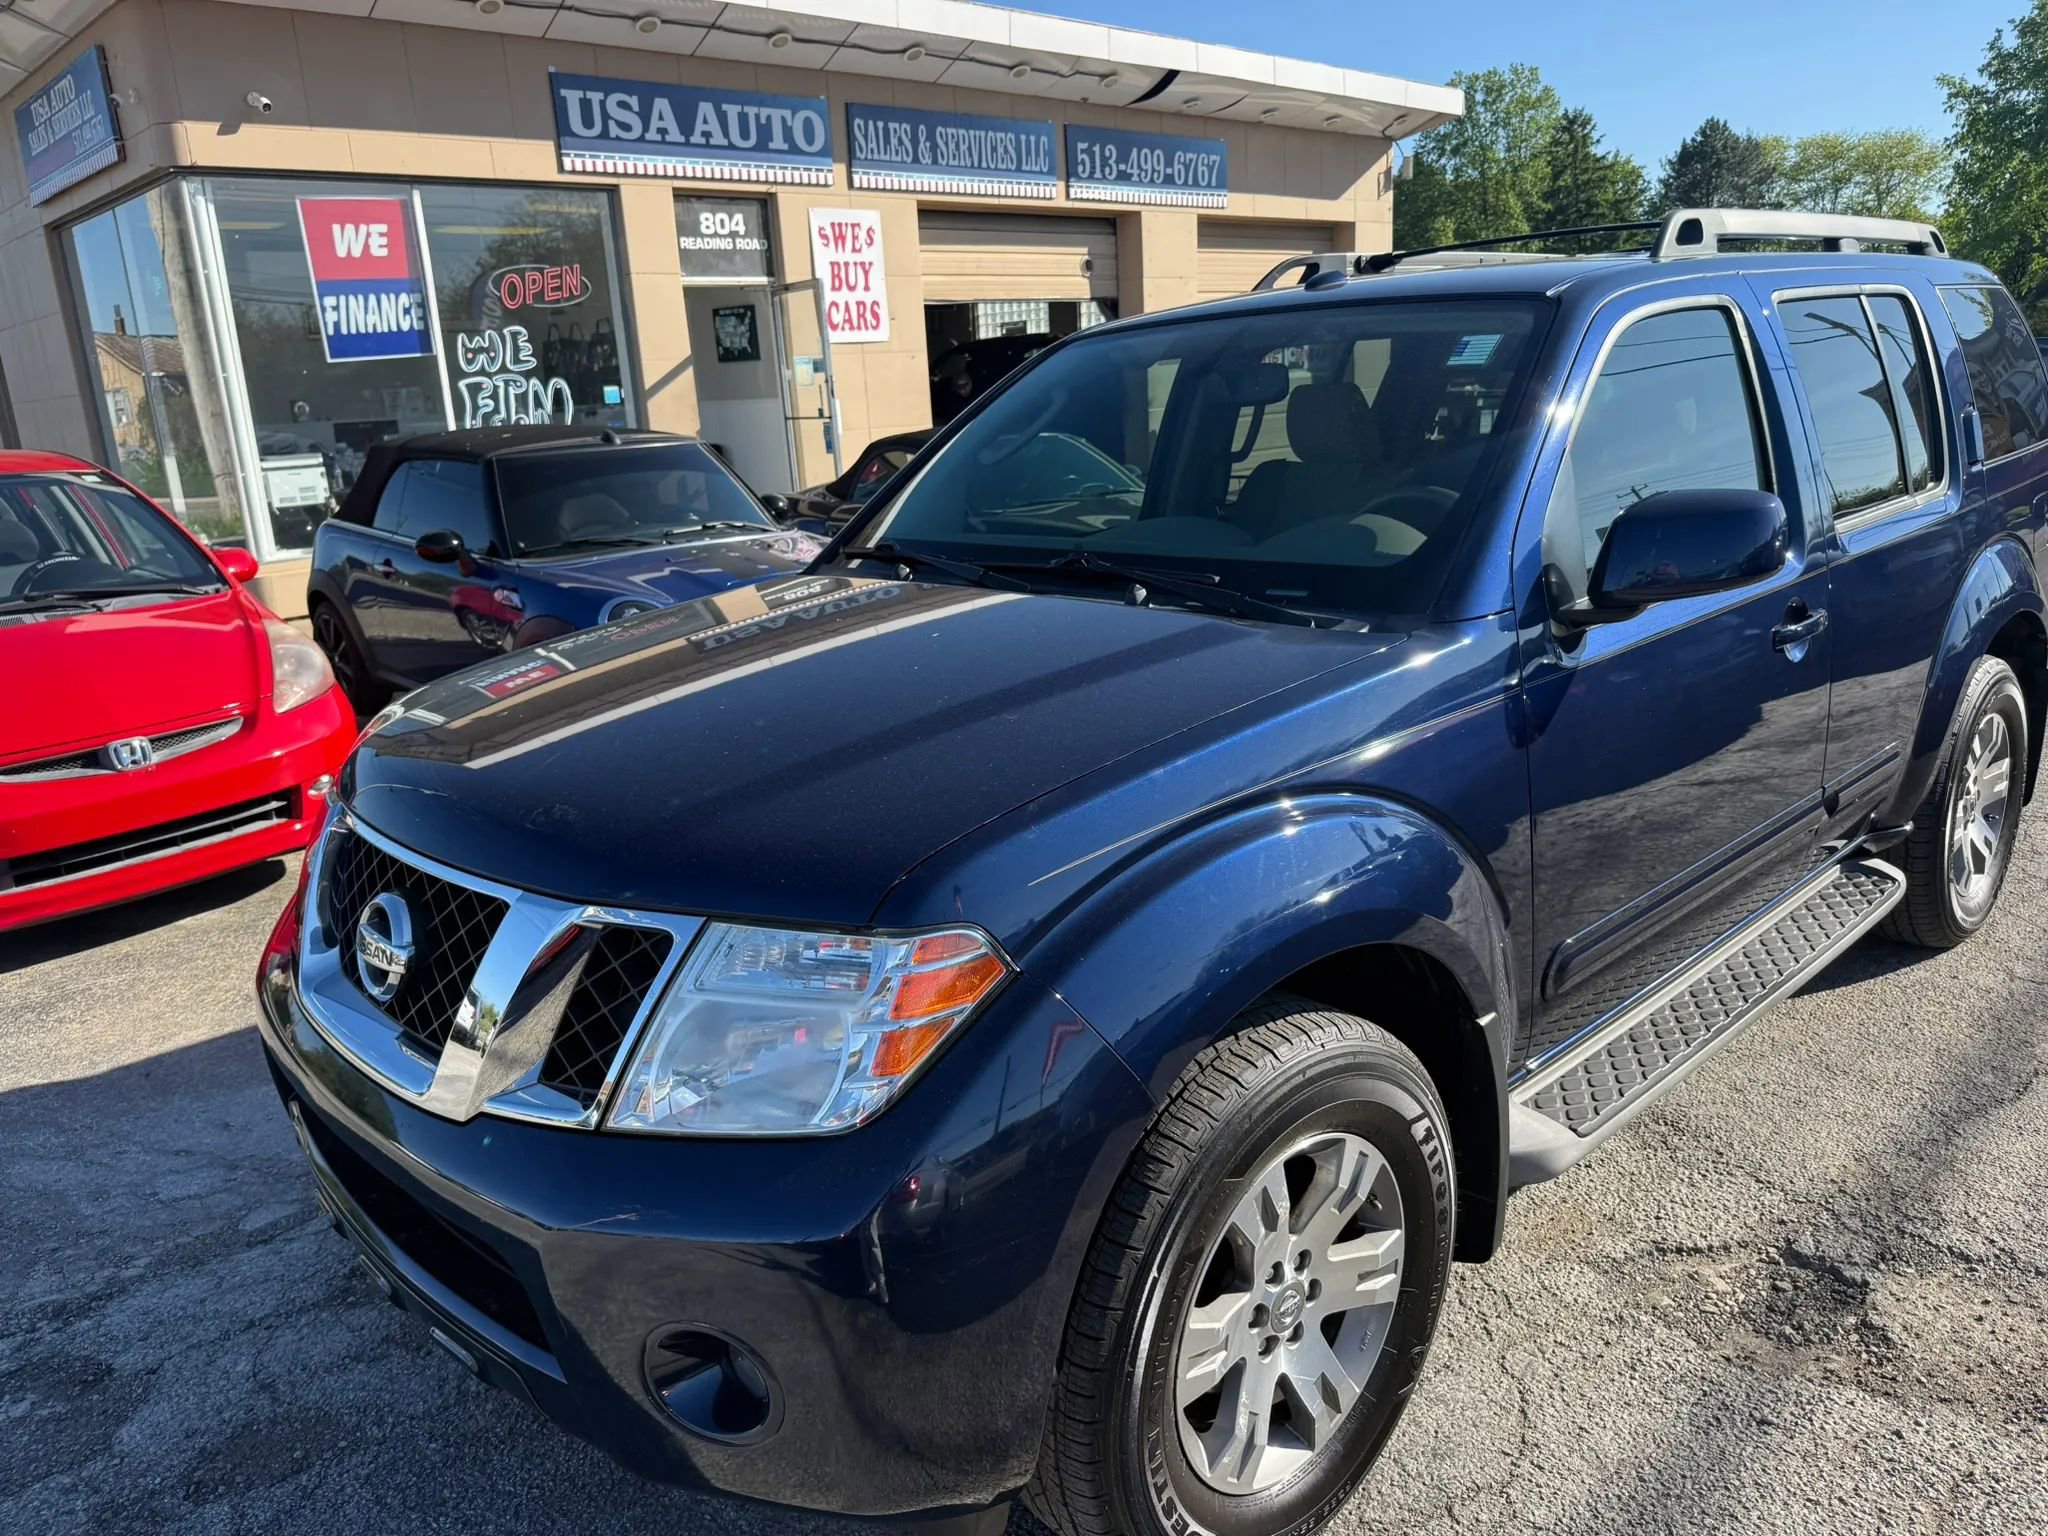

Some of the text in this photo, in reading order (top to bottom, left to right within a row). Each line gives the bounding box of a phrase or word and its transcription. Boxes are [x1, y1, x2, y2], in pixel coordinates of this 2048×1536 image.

[560, 88, 826, 153] USA AUTO
[853, 118, 1049, 172] SALES & SERVICES LLC
[1077, 142, 1221, 187] 513-499-6767
[331, 223, 389, 258] WE
[679, 237, 768, 250] READING ROAD
[700, 212, 746, 235] 804
[501, 264, 581, 309] OPEN
[830, 261, 873, 292] BUY
[323, 292, 425, 336] FINANCE
[827, 300, 881, 332] CARS
[457, 325, 538, 373] WE
